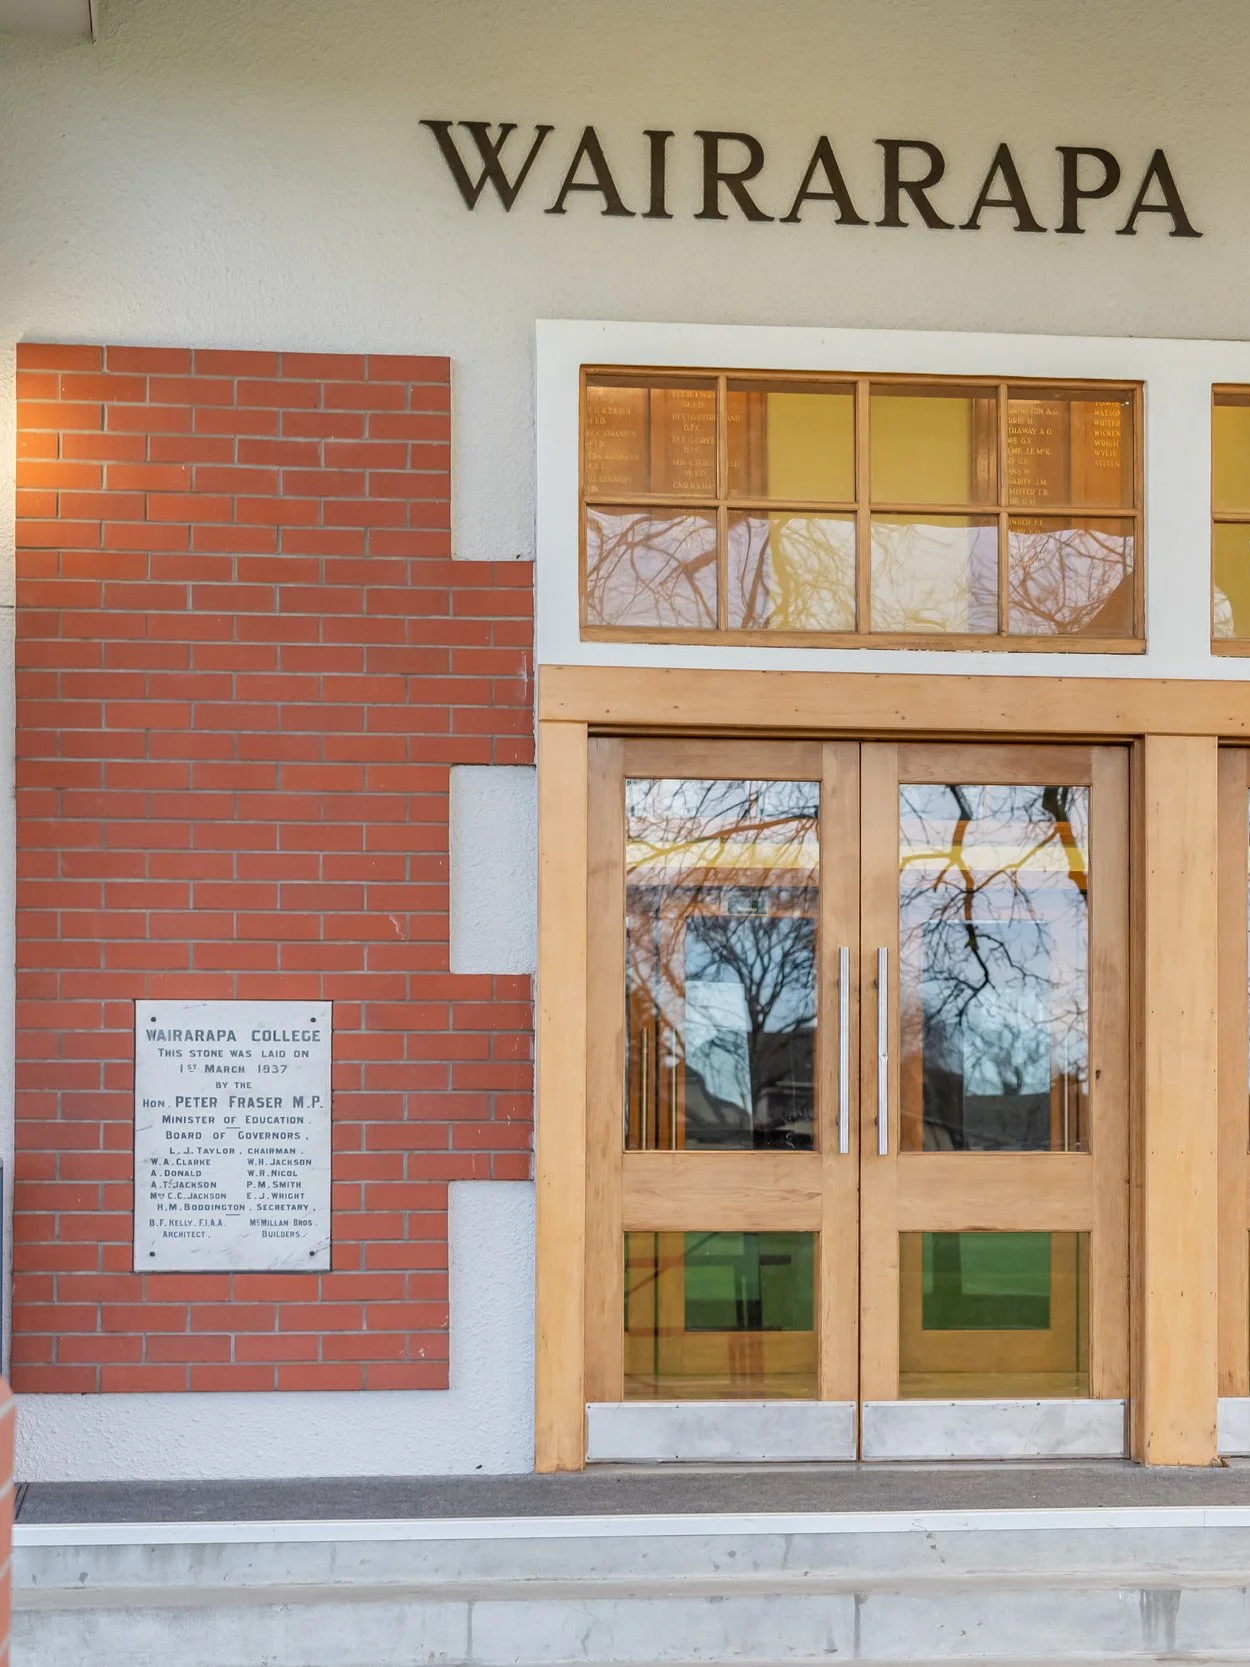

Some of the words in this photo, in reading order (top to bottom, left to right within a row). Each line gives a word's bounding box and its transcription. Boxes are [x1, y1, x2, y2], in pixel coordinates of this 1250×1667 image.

[418, 120, 1204, 238] WAIRARAPA
[146, 1029, 237, 1042] WAIRARAPA
[251, 1030, 321, 1042] COLLEGE
[158, 1048, 182, 1058] THIS
[189, 1049, 224, 1058] STONE
[229, 1050, 252, 1058] WAS
[261, 1050, 286, 1058] LAID
[293, 1050, 309, 1058] ON
[204, 1064, 245, 1074] MARCH
[175, 1096, 218, 1108] PETER
[229, 1096, 283, 1109] FRASER
[162, 1115, 215, 1124] MINISTER
[224, 1116, 237, 1124] OF
[165, 1131, 202, 1140] BOARD
[213, 1132, 226, 1140] OF
